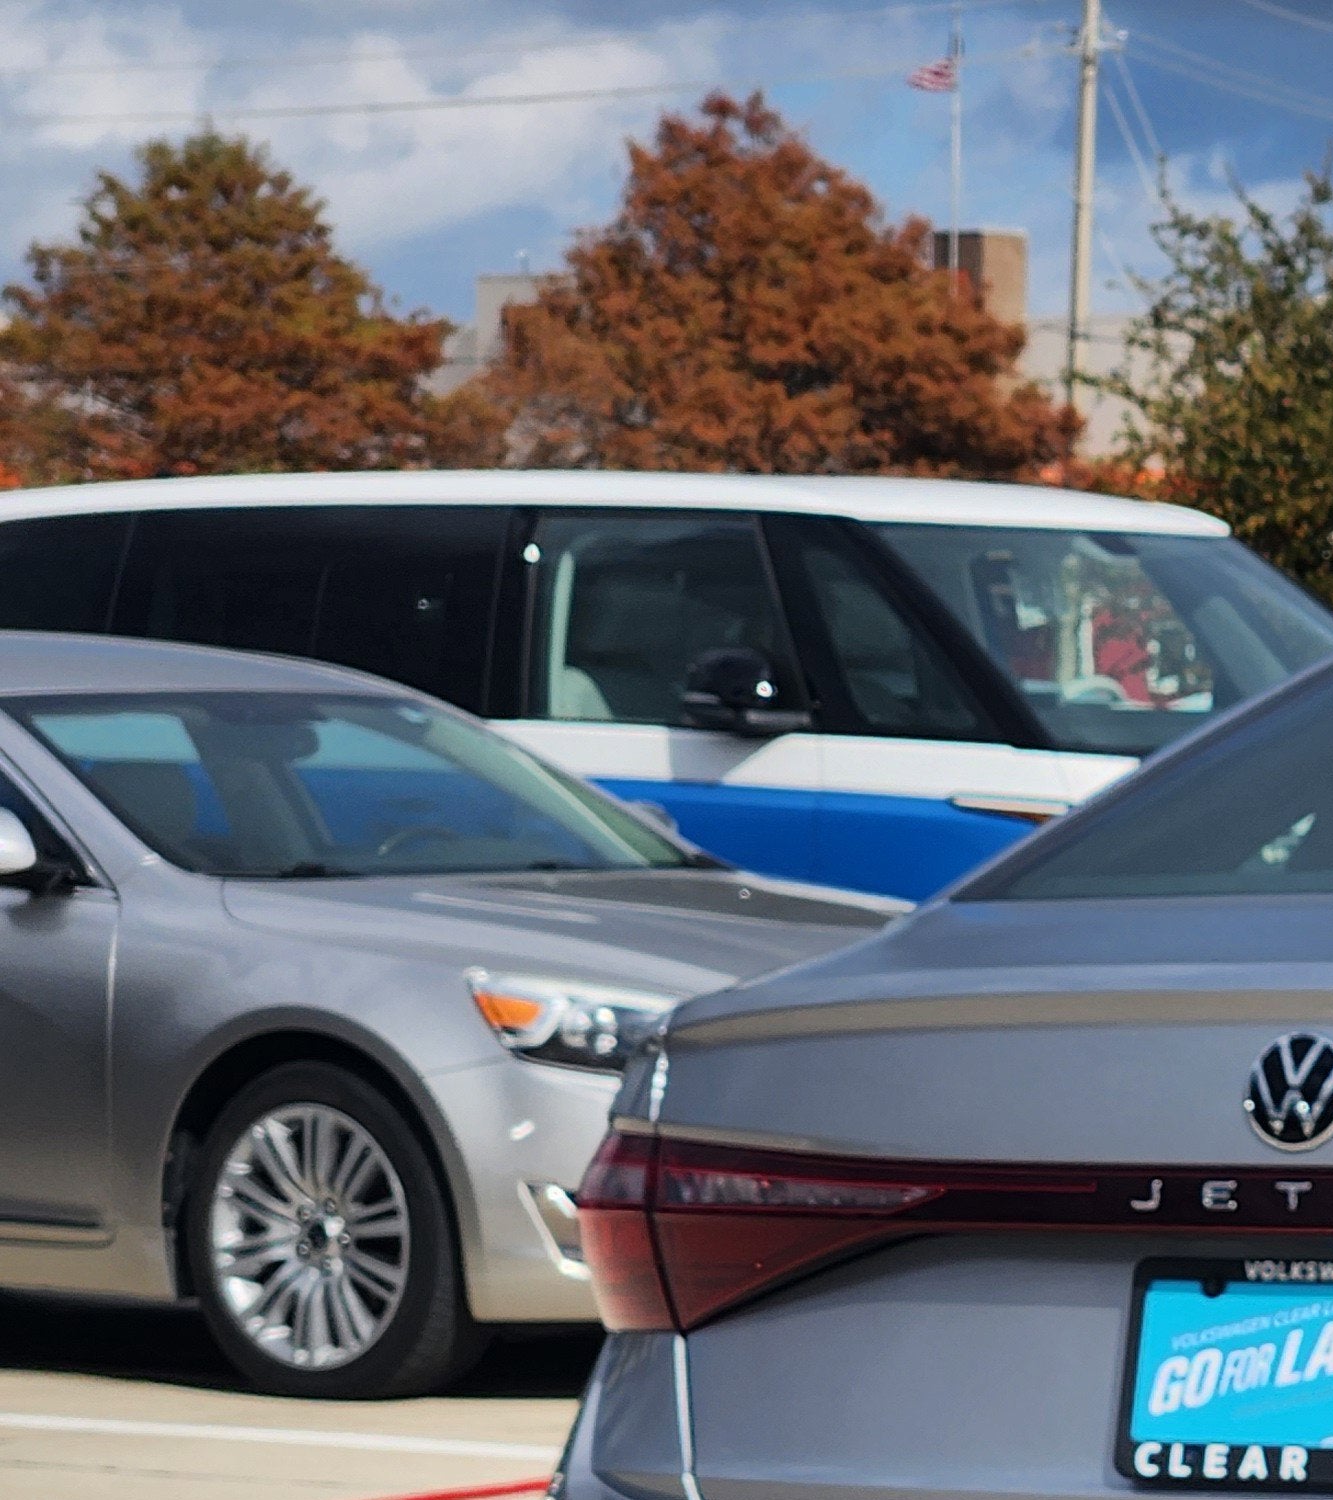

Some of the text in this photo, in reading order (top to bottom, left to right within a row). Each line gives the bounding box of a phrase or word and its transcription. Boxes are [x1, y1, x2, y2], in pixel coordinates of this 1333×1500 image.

[1171, 1315, 1271, 1350] VOLKSWAGEN
[1272, 1302, 1322, 1327] CLEAR
[1149, 1347, 1224, 1417] GO
[1218, 1342, 1277, 1397] FOR
[1134, 1441, 1309, 1482] CLEAR
